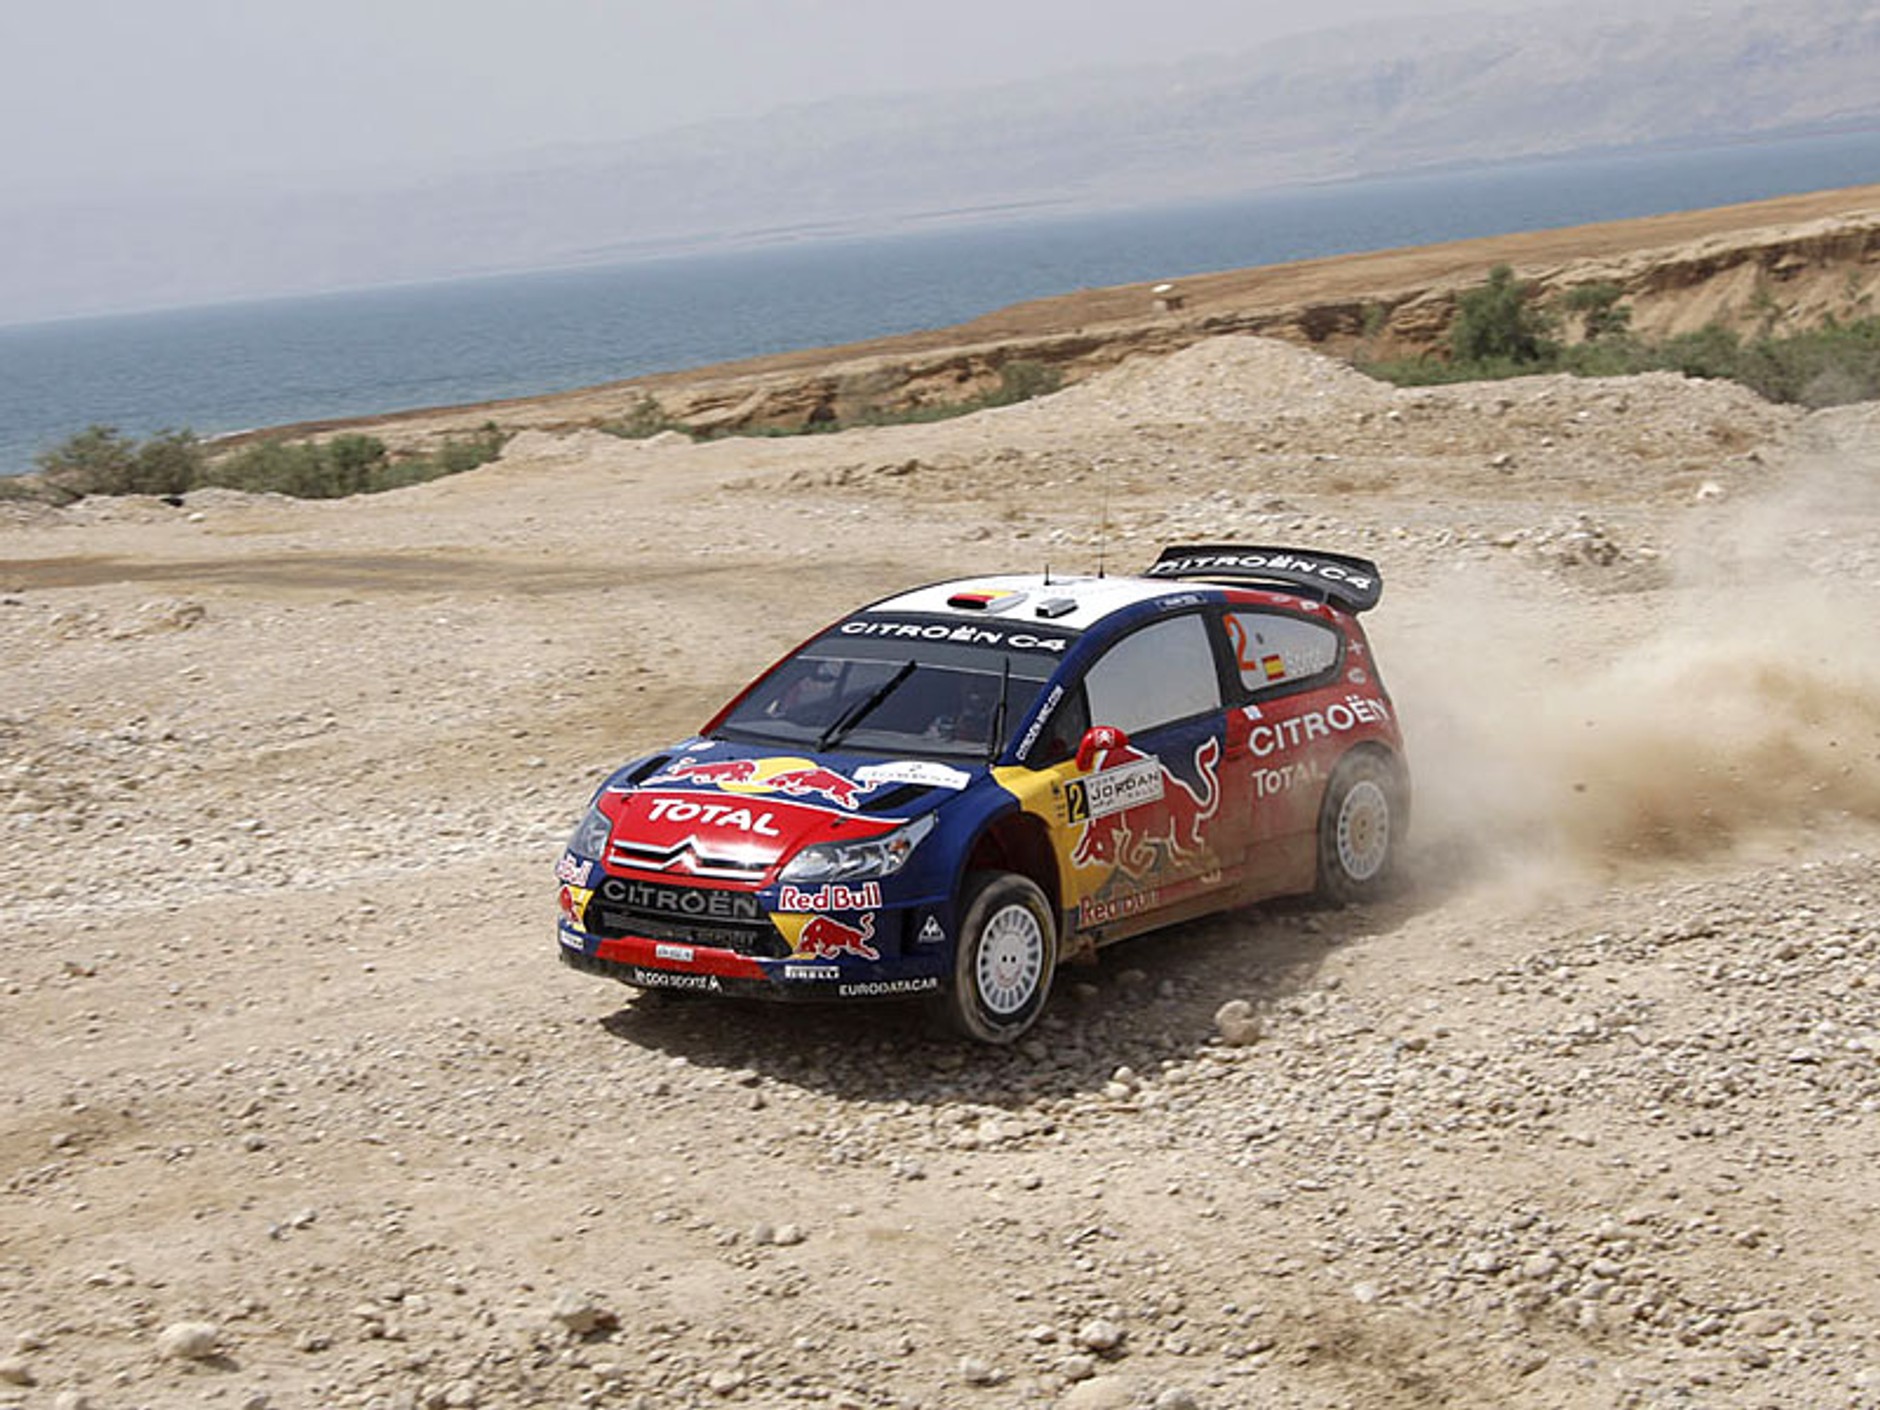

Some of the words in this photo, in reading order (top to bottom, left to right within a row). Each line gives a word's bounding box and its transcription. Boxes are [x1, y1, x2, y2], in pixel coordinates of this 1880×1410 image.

[1150, 554, 1317, 574] CITROËN
[1319, 566, 1372, 590] C4
[841, 621, 1003, 643] CITROËN
[1008, 634, 1067, 651] C4
[1222, 613, 1256, 670] 2
[1248, 694, 1390, 757] CITROËN
[1091, 770, 1159, 801] JORDAN
[1252, 760, 1328, 799] TOTAL
[648, 798, 780, 837] TOTAL
[1069, 784, 1086, 820] 2
[603, 879, 758, 918] CITROËN
[778, 884, 831, 911] Red
[832, 881, 883, 910] Bull
[838, 977, 939, 997] EURODATACAR
